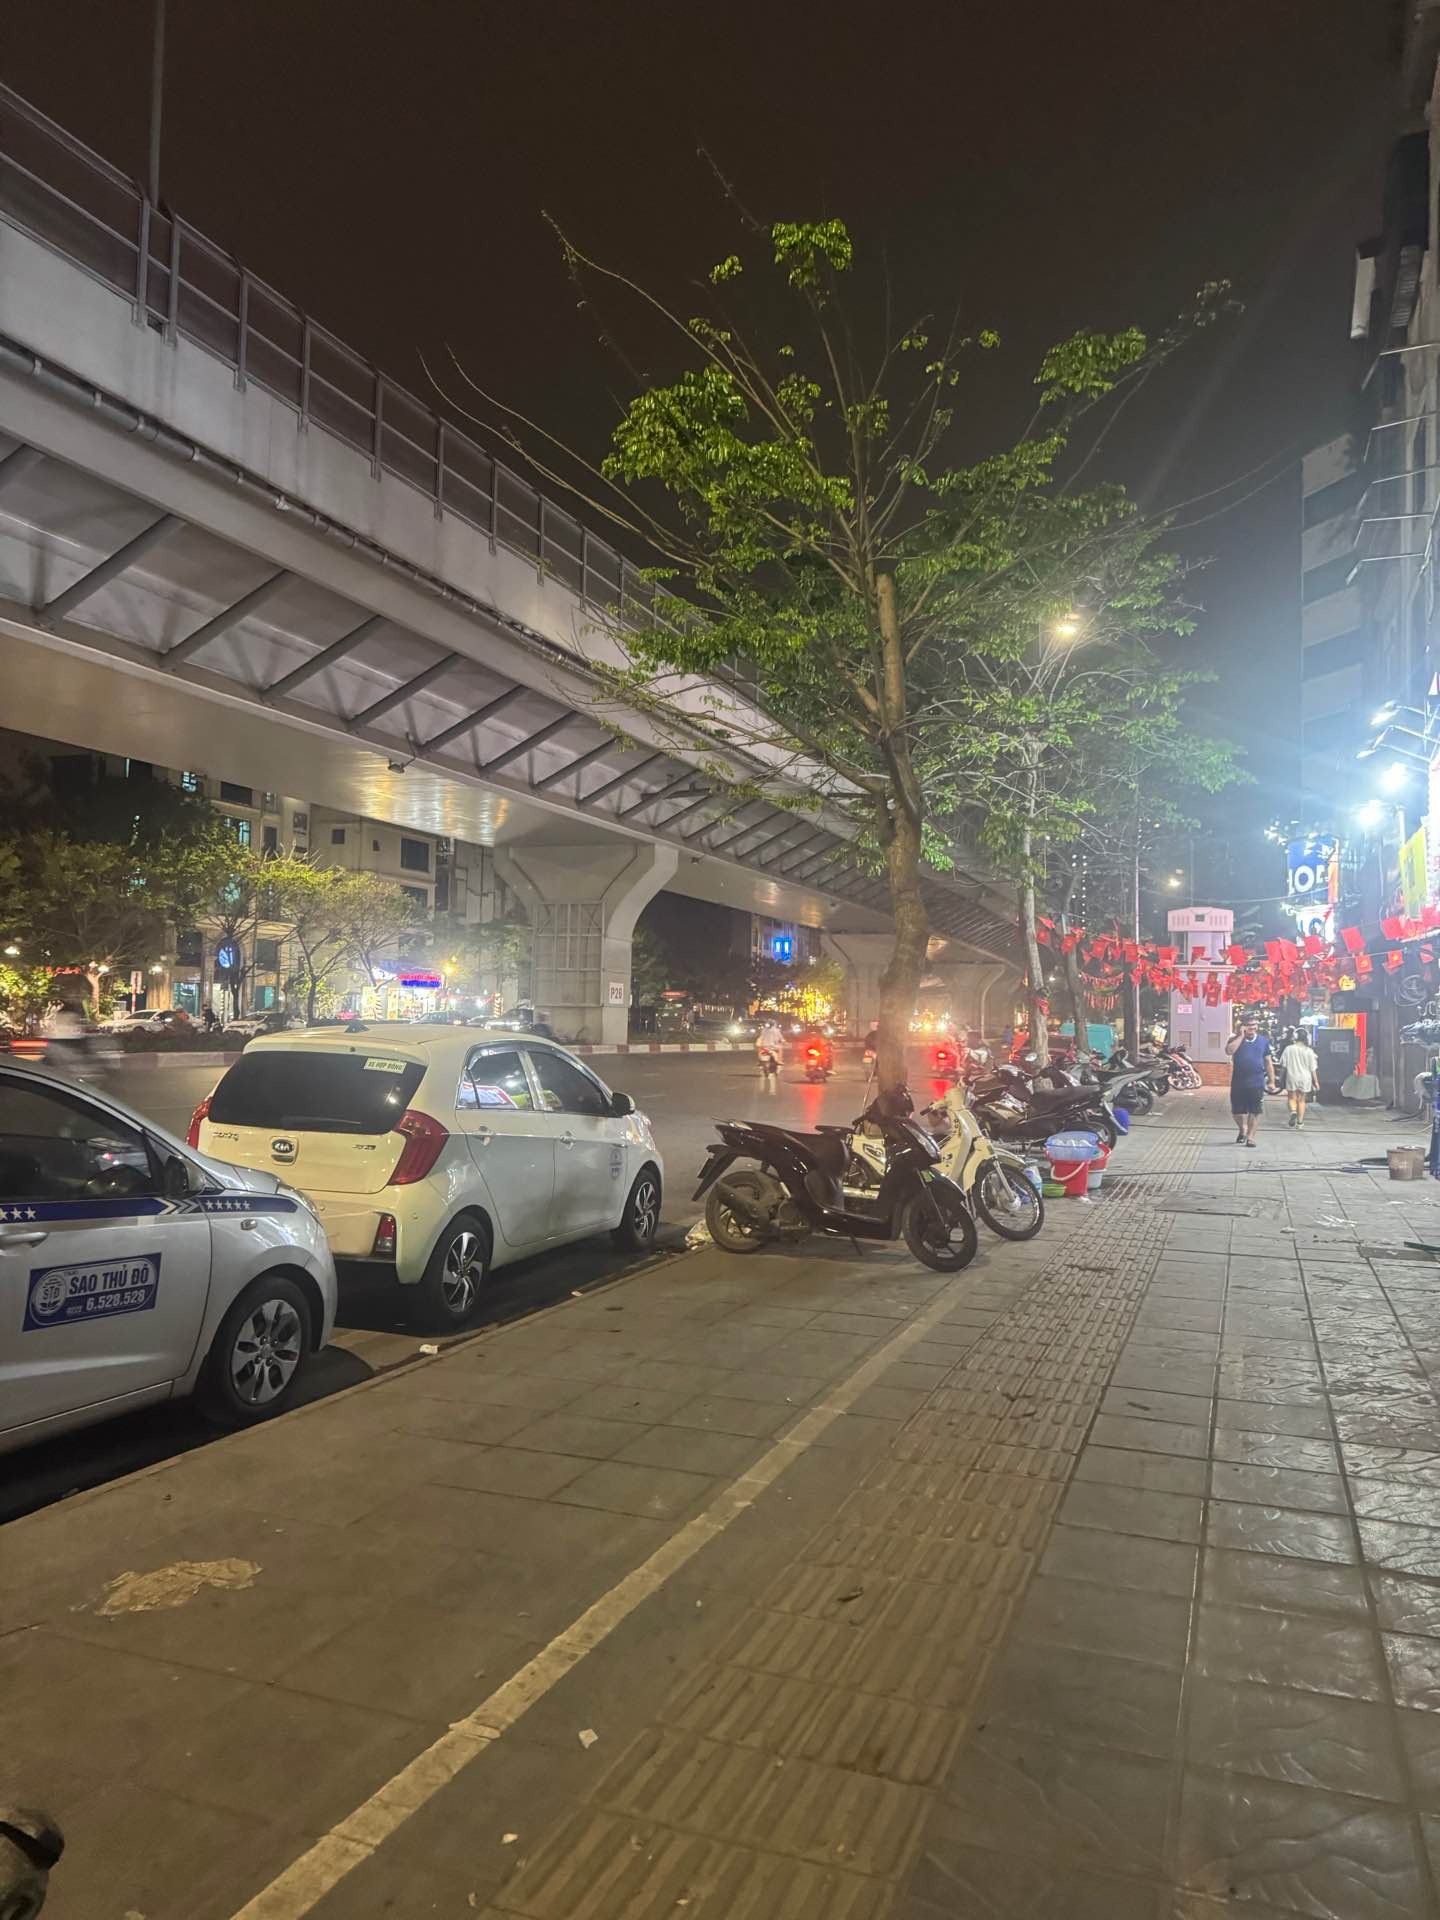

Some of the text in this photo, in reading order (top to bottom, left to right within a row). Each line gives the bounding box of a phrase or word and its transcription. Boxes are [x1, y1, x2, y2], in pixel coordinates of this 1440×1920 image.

[274, 1142, 290, 1151] KIA
[69, 1264, 149, 1295] SAO THỦ ĐÔ
[86, 1289, 145, 1311] 6.528.528
